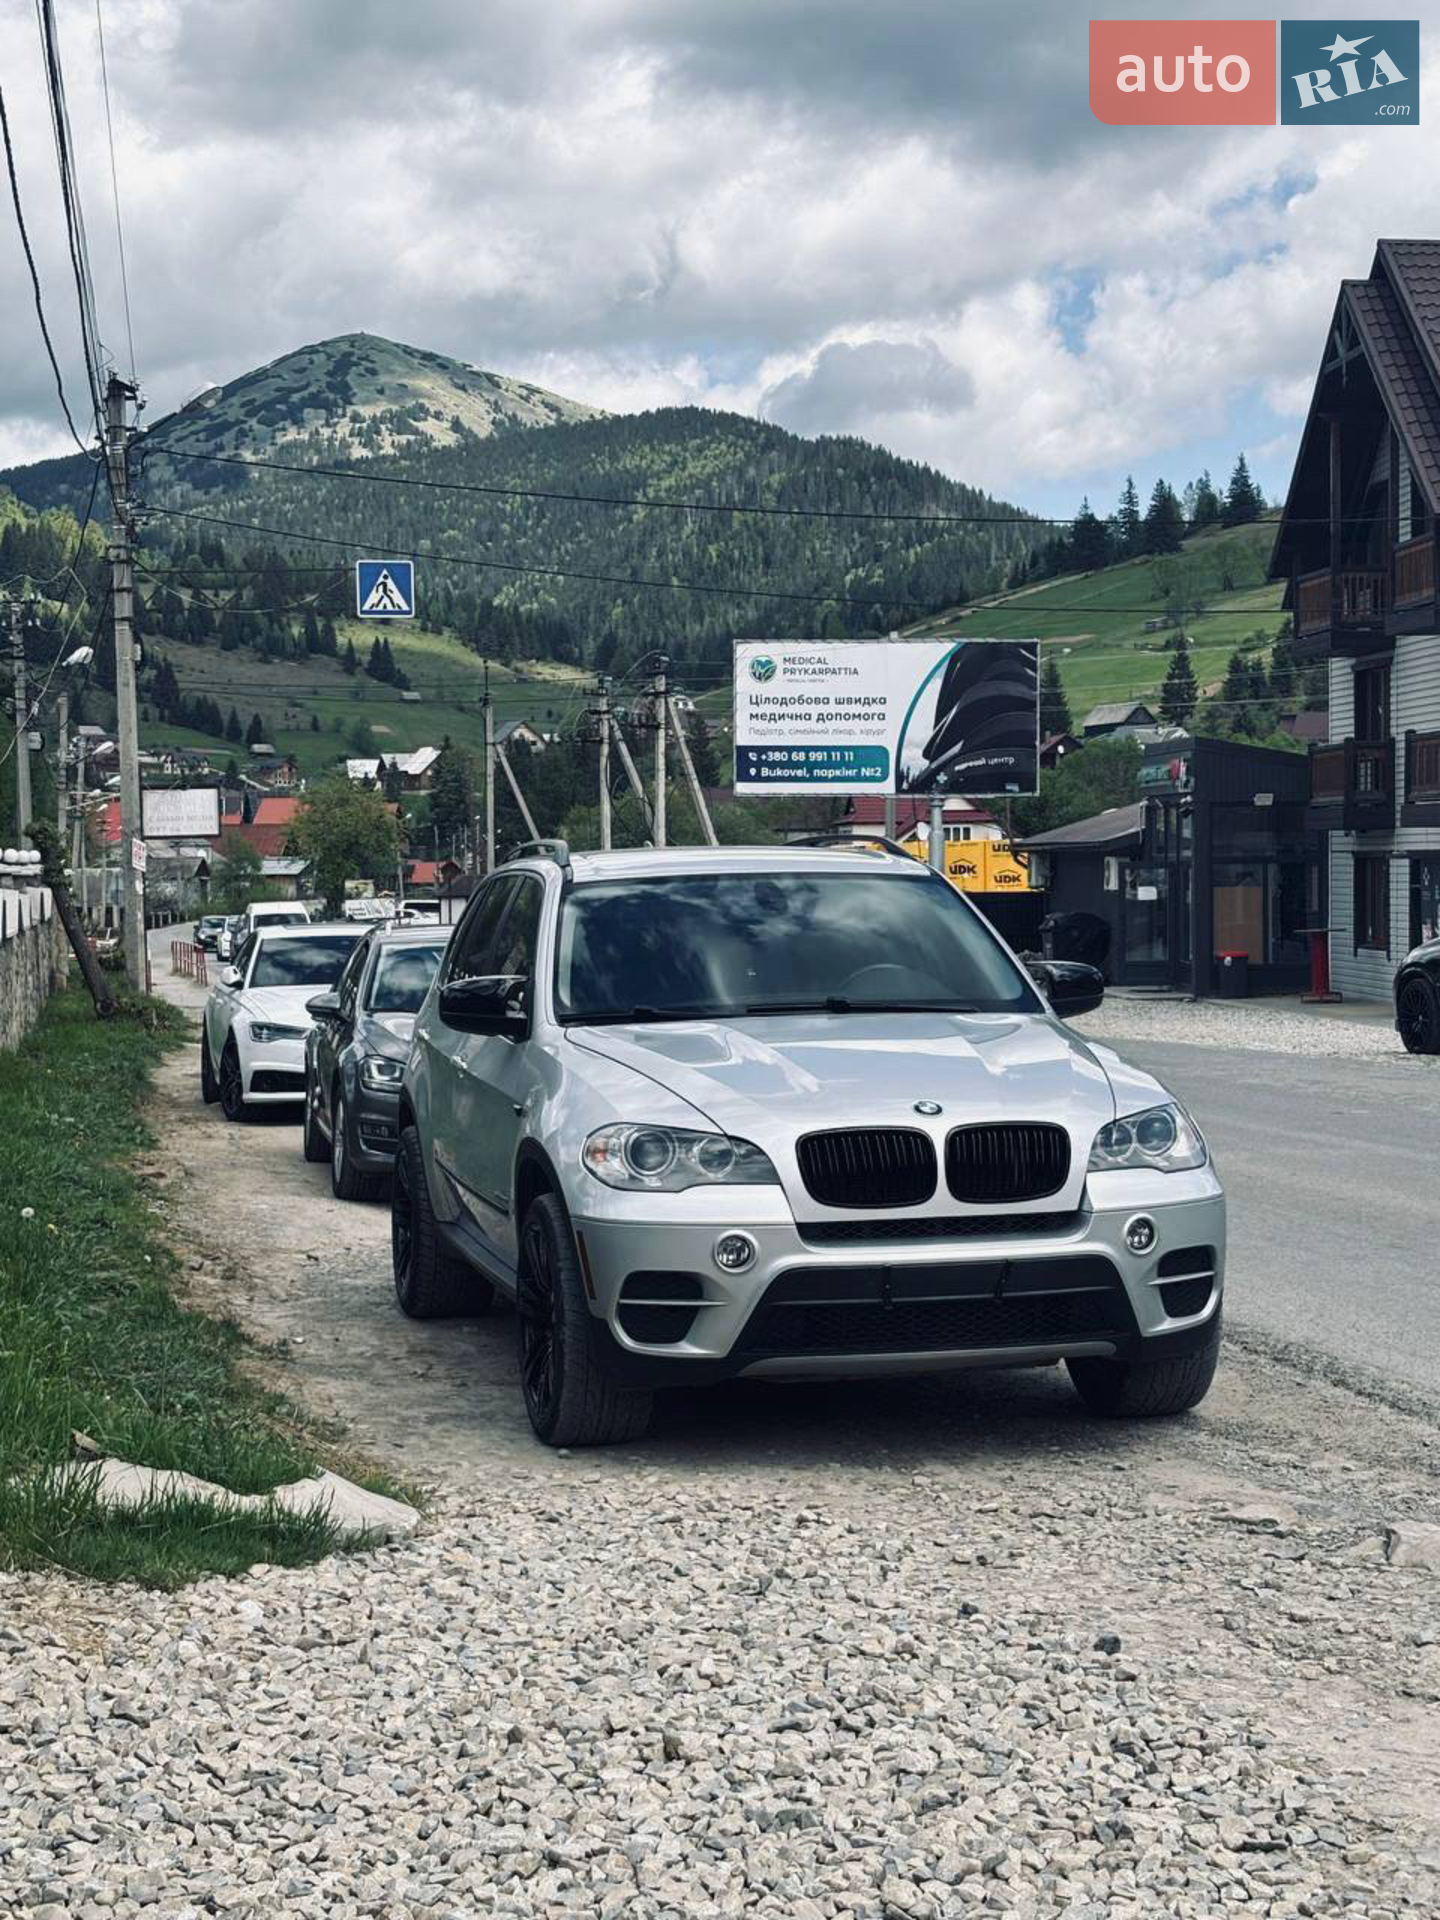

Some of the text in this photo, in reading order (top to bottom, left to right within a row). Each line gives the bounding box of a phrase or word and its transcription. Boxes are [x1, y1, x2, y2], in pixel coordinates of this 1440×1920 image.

[782, 656, 829, 666] MEDICAL
[782, 667, 859, 676] PRYKARPATTIA
[749, 694, 888, 708] Цілодобова швидка
[749, 711, 886, 723] медична допомога
[760, 751, 854, 762] +380 68 991 11 11
[987, 757, 1015, 766] центр
[760, 766, 882, 779] Bukovel, паркінг №2
[949, 864, 977, 876] UDK
[993, 873, 1022, 884] UDK
